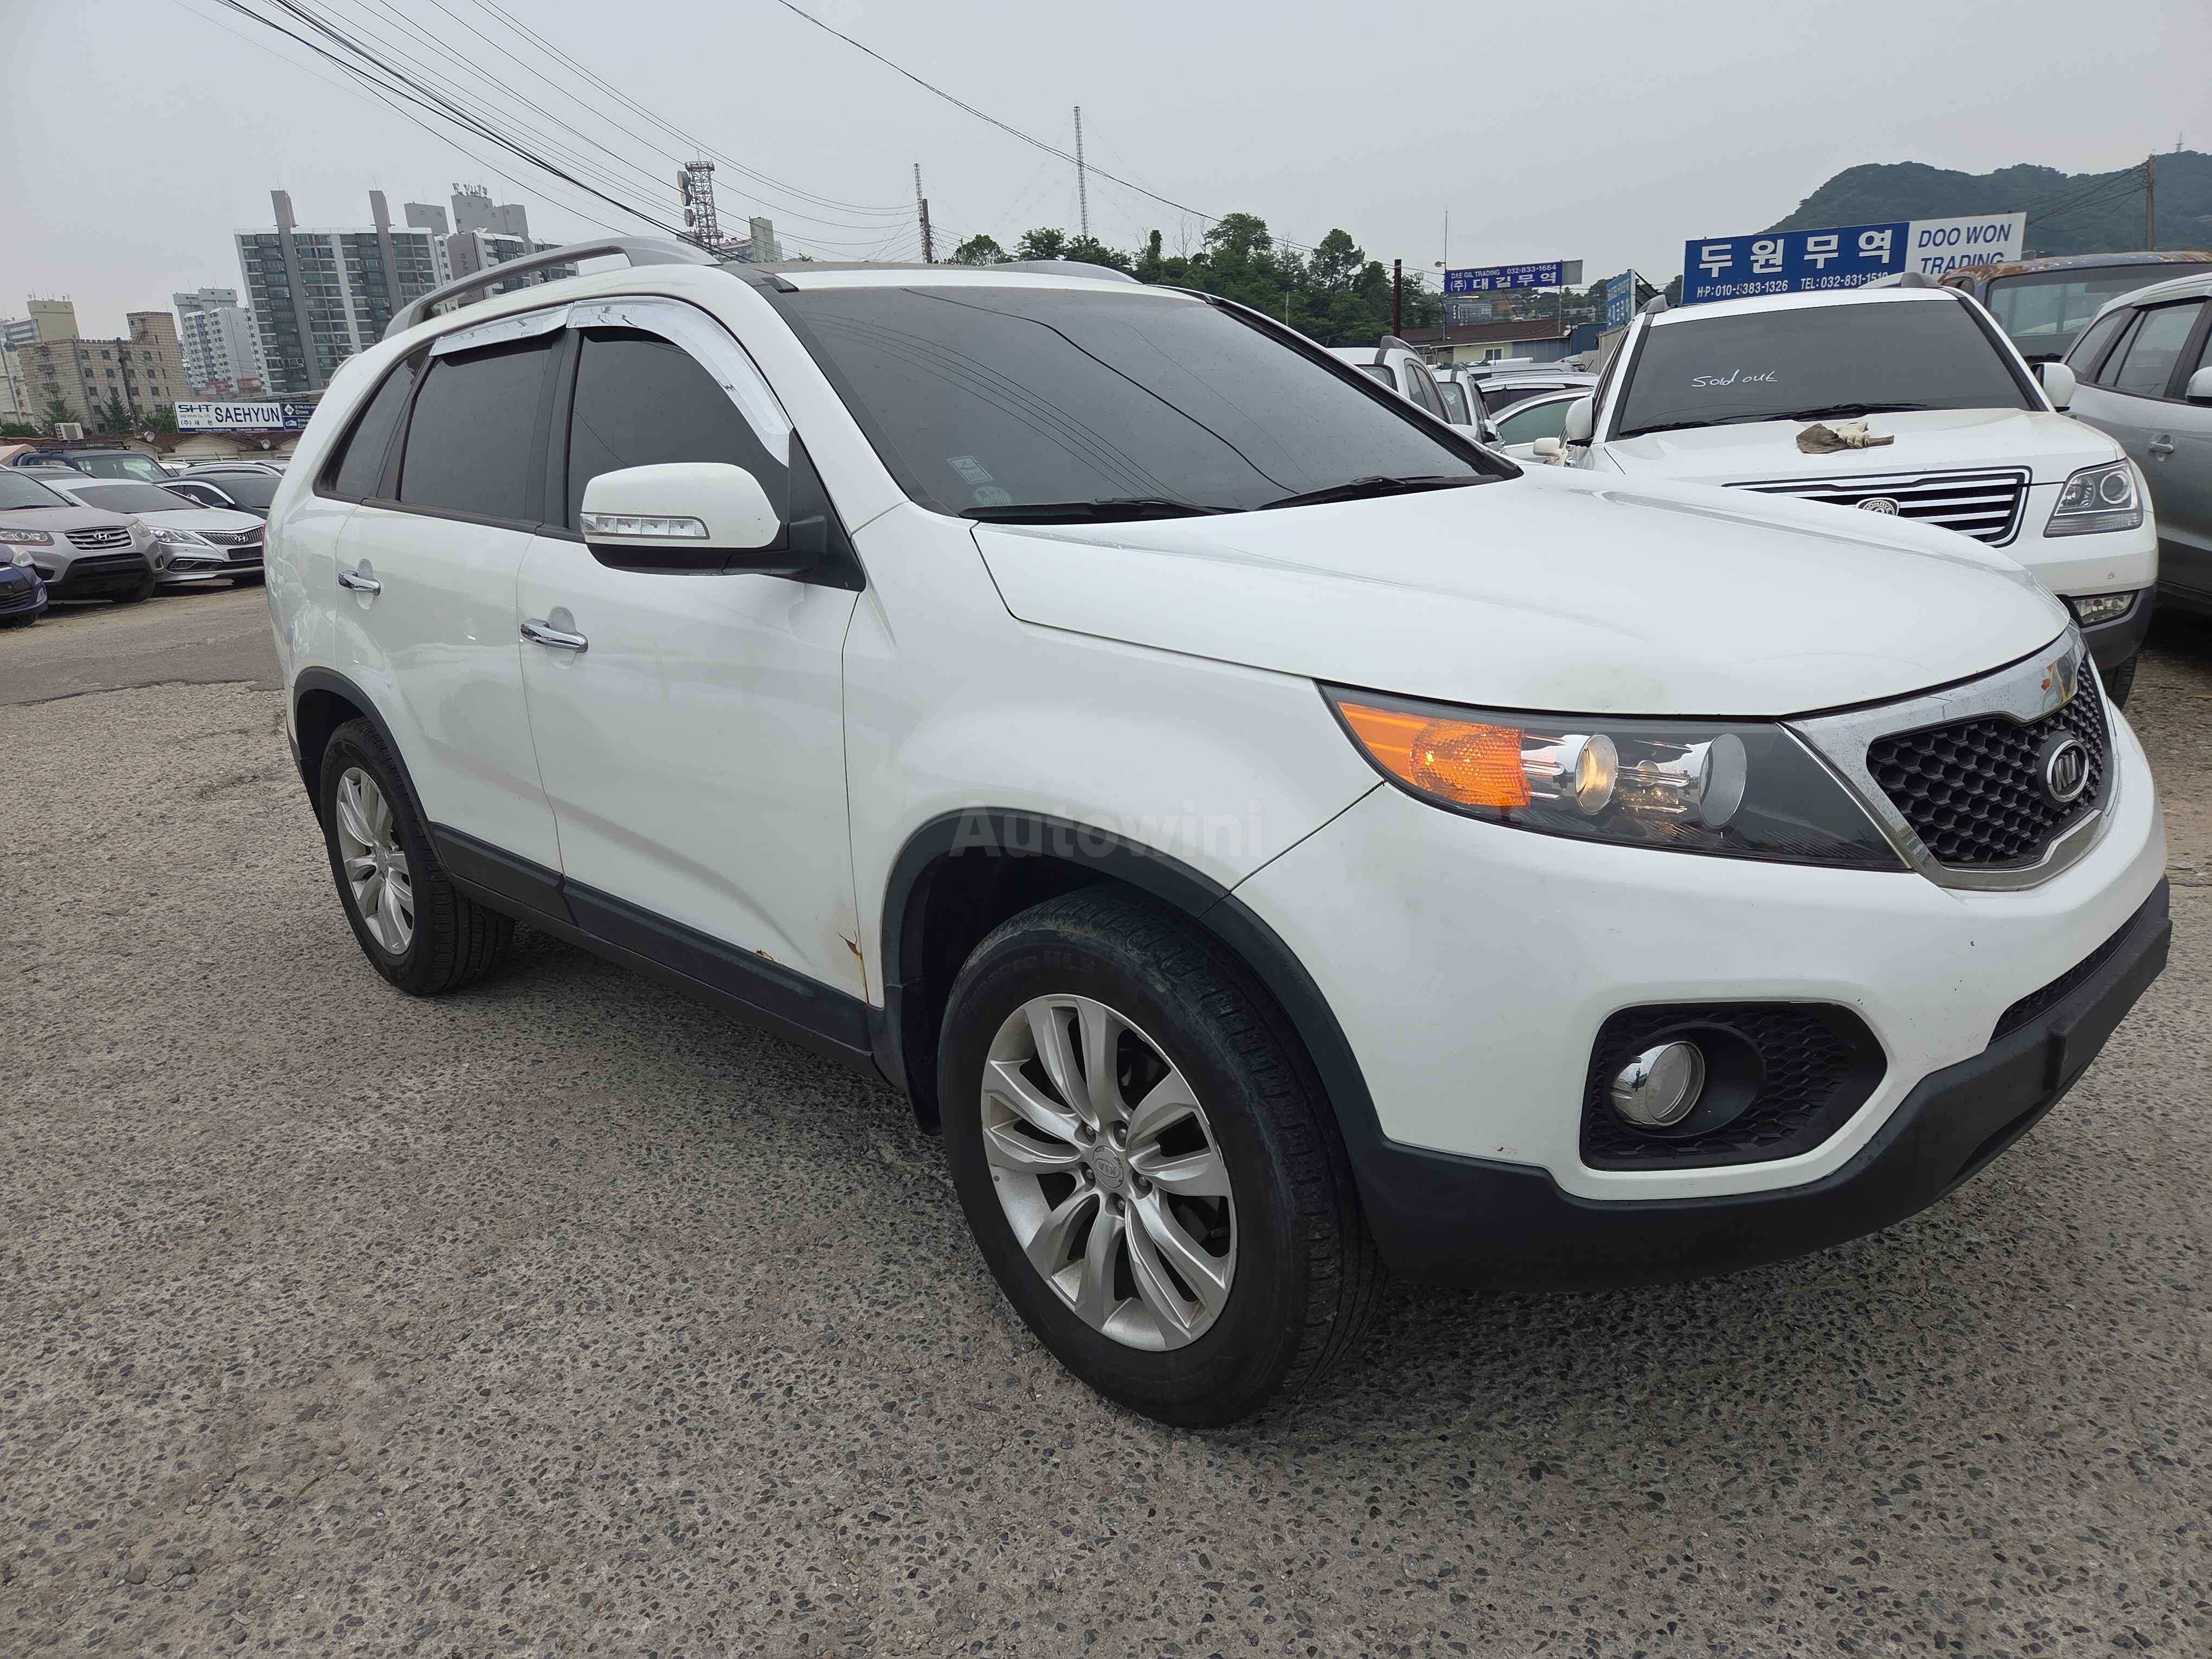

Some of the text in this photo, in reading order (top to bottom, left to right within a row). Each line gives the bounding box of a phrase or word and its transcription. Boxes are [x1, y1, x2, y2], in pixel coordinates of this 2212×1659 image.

[1918, 223, 2012, 248] DOO WON
[1699, 229, 1893, 278] 두원무역
[1921, 252, 2004, 274] TRADING
[1451, 272, 1557, 292] (주) 대길무역
[178, 404, 212, 413] SHT
[215, 407, 280, 423] SAEHYUN
